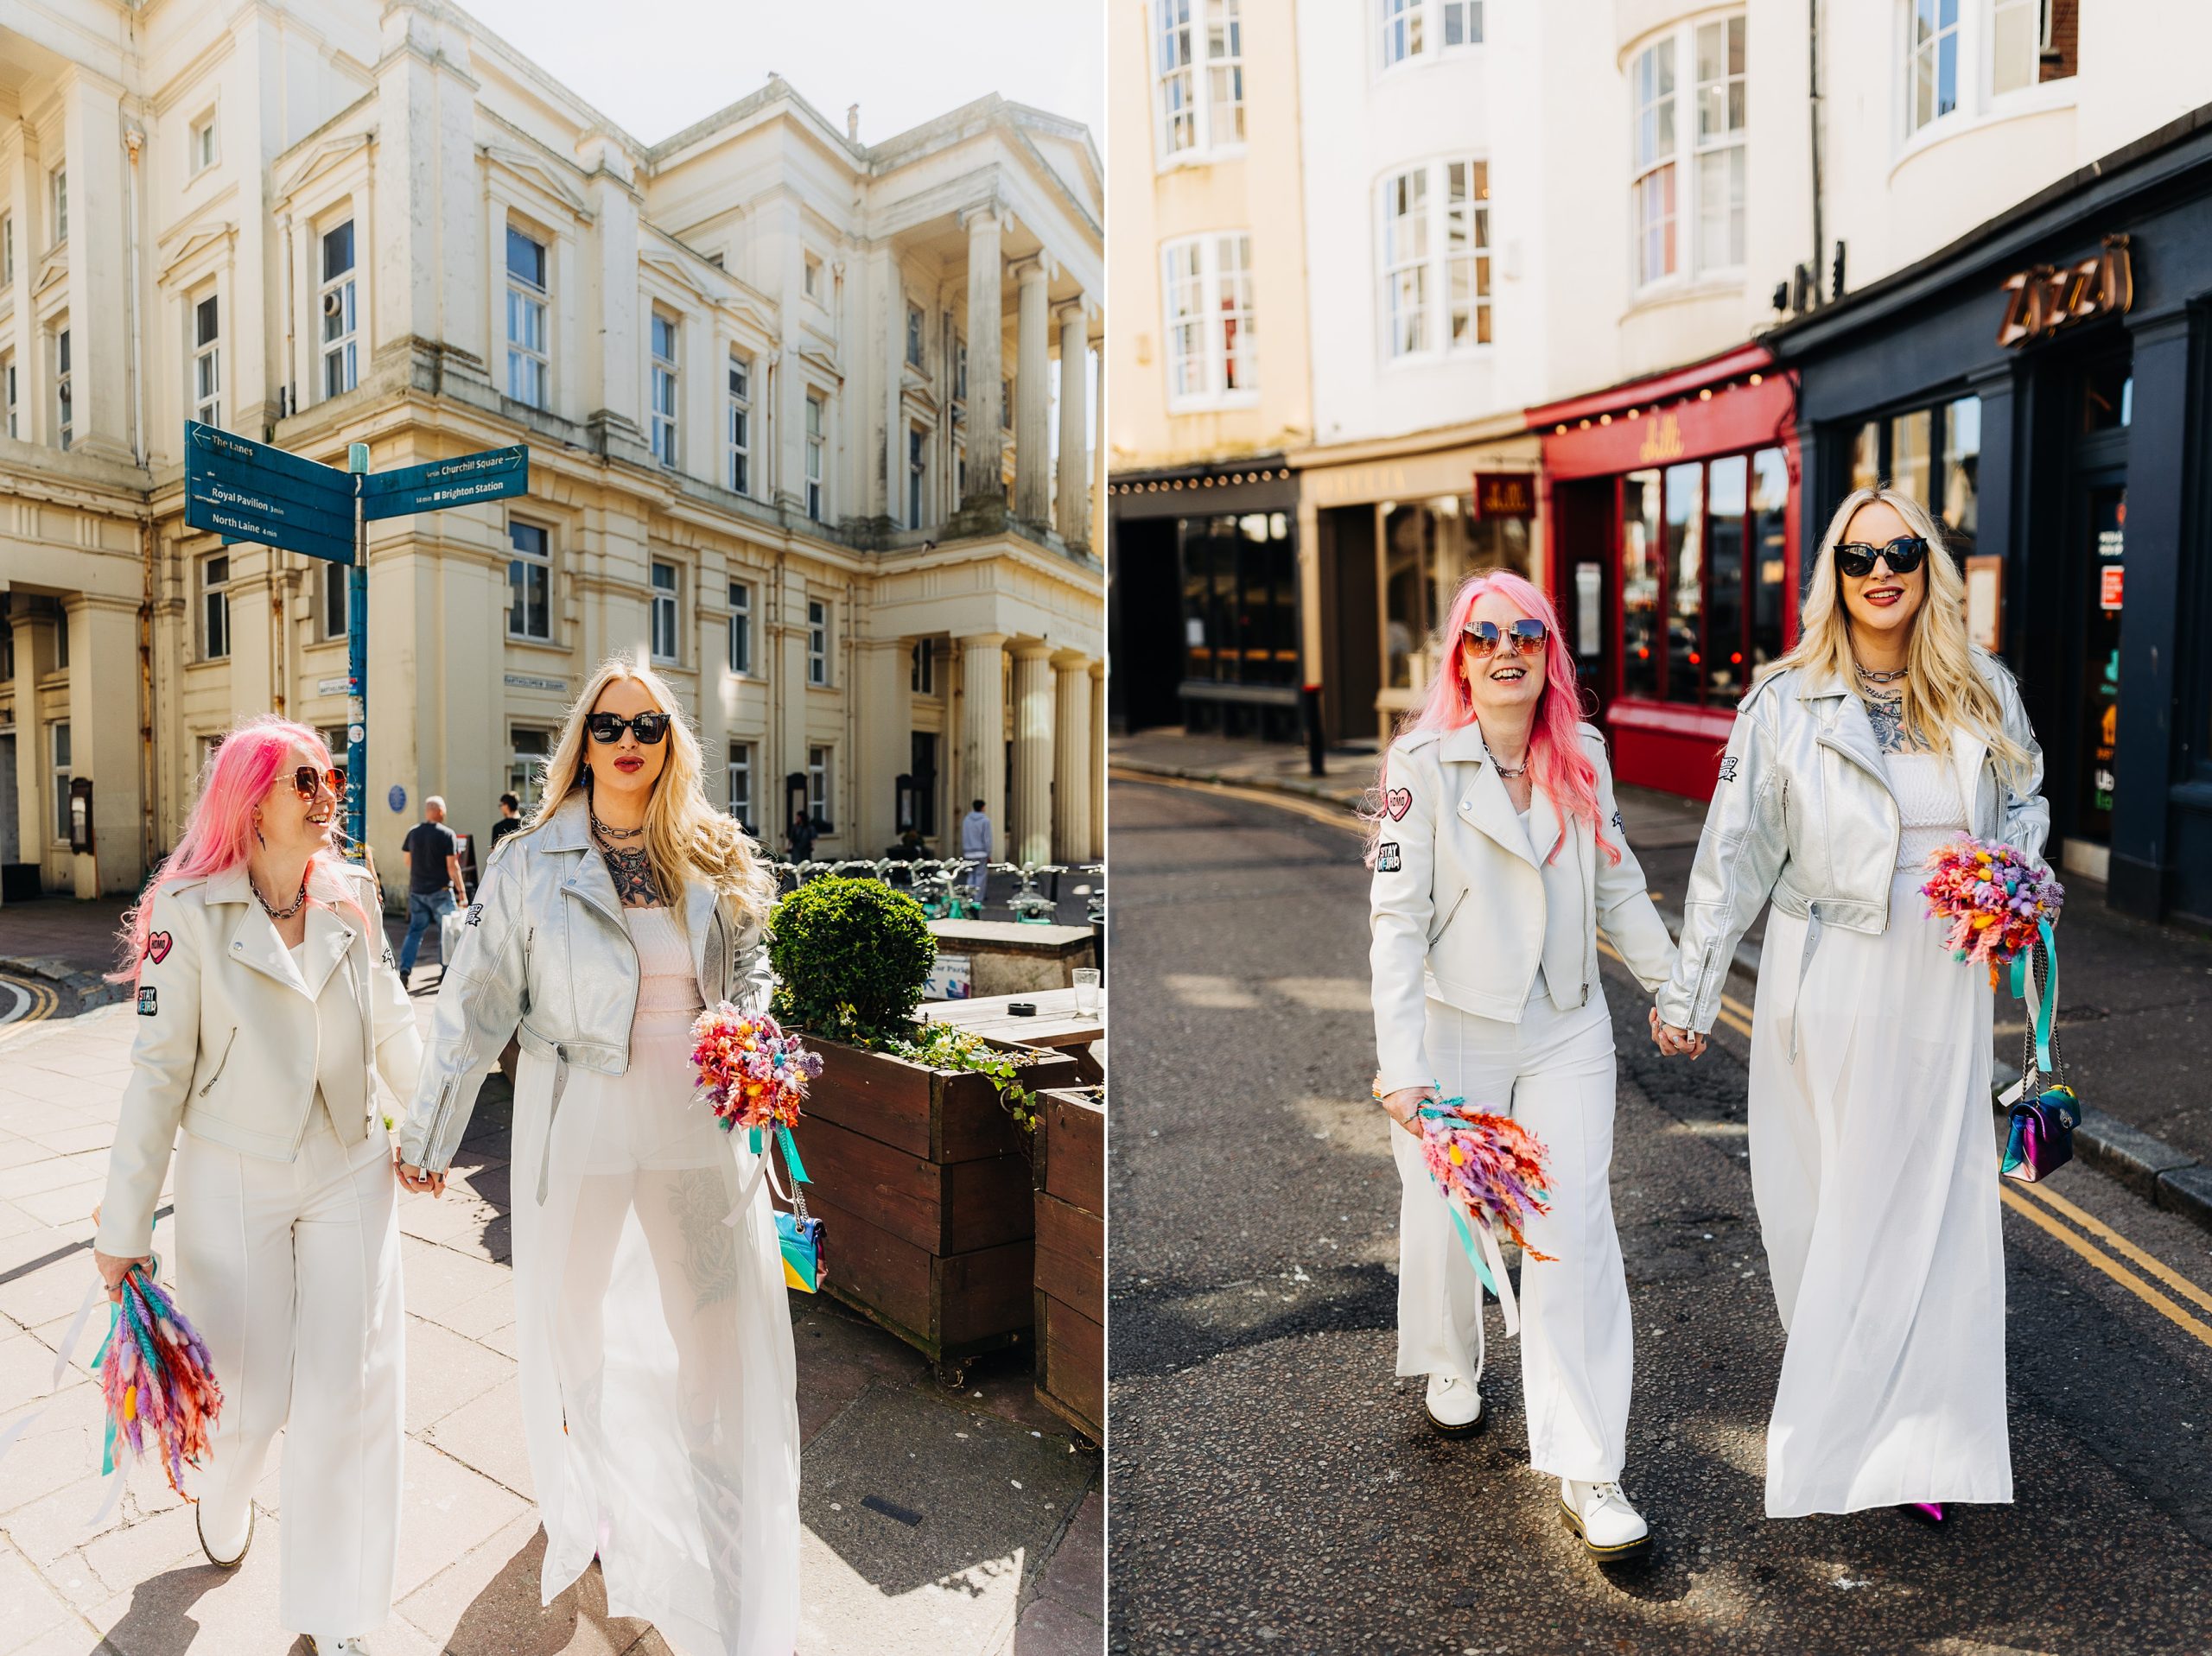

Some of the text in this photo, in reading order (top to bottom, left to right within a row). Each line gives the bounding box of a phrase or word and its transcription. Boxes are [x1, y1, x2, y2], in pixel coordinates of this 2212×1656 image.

[212, 435, 253, 457] The Lanes
[442, 460, 474, 475] Churchill
[476, 457, 504, 469] Square
[442, 486, 474, 499] Brighton
[475, 481, 504, 494] Station
[212, 487, 236, 503] Royal
[237, 495, 268, 511] Pavilion
[213, 513, 237, 528] North
[238, 520, 260, 534] Laine
[1389, 796, 1405, 807] HOMO
[1380, 844, 1398, 858] STAY
[1377, 855, 1401, 871] WEIRD
[151, 939, 166, 949] HOMO
[139, 989, 156, 1001] STAY
